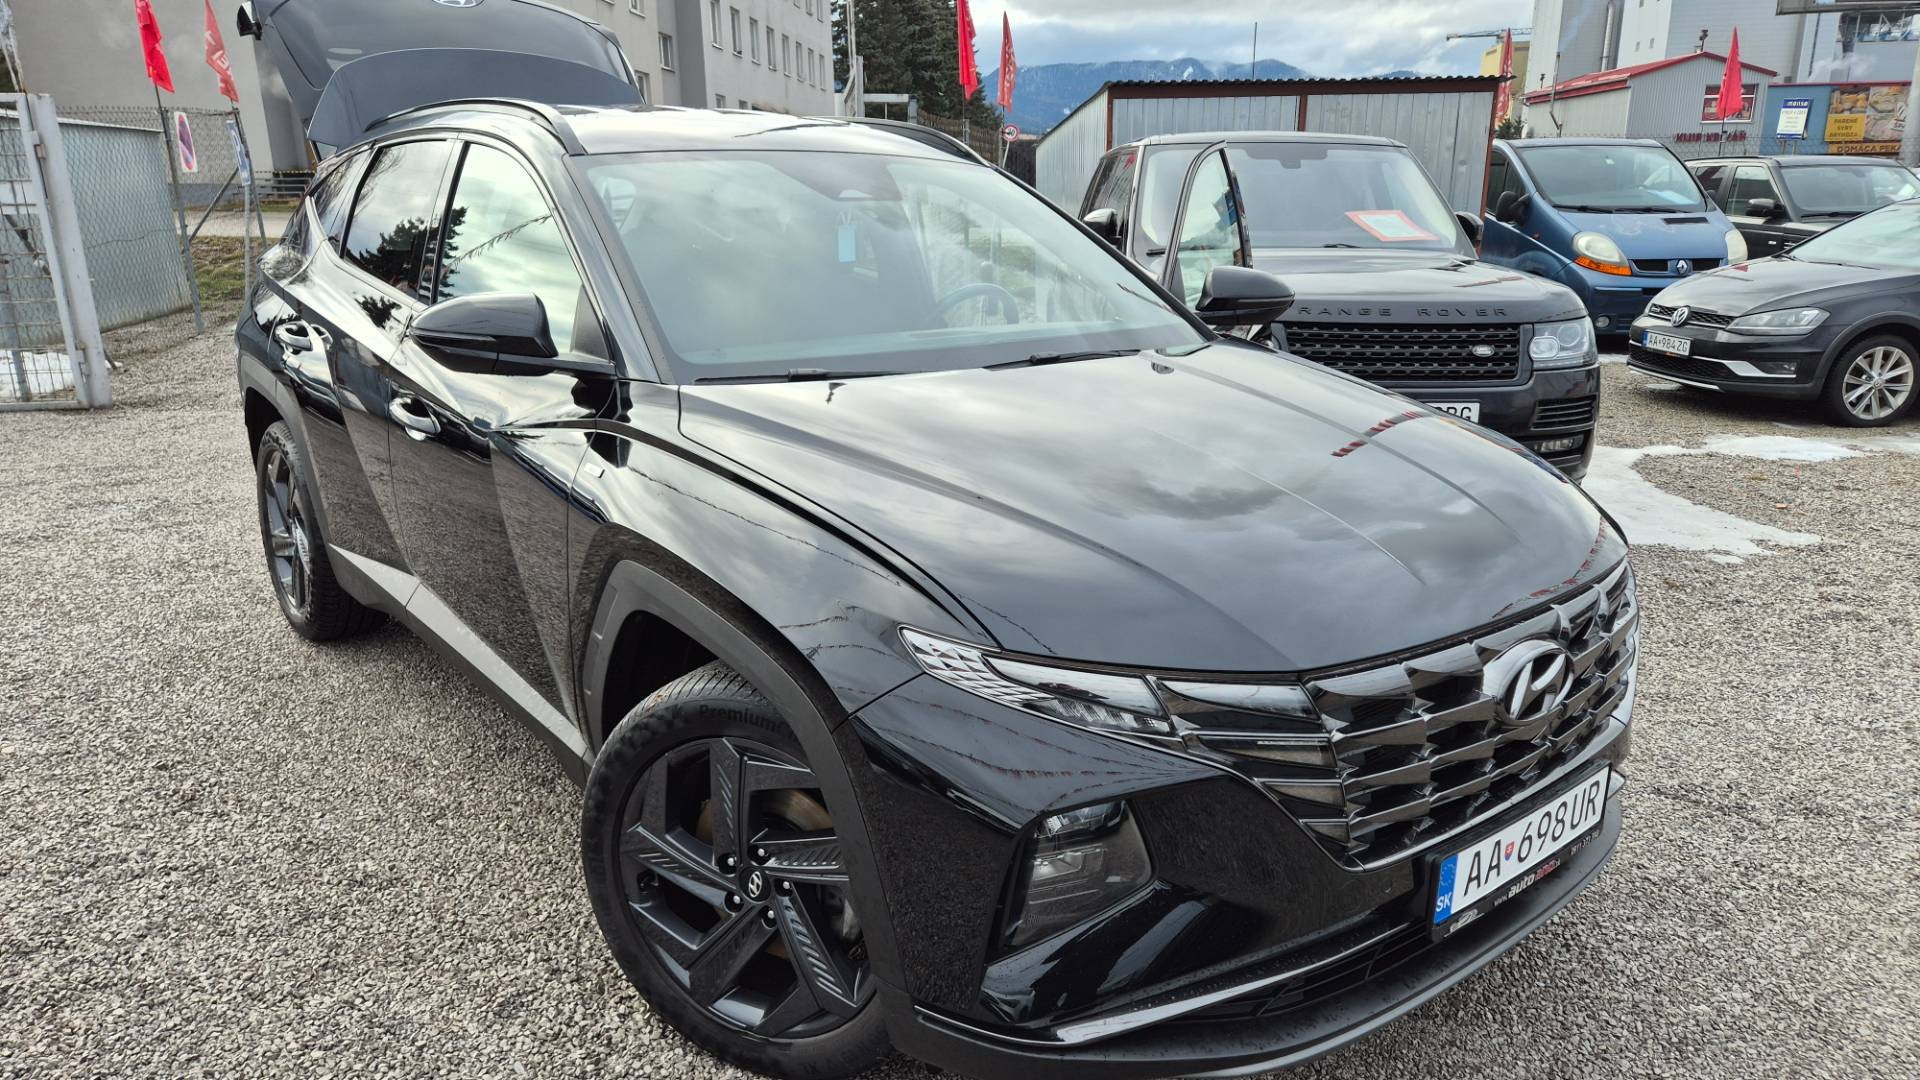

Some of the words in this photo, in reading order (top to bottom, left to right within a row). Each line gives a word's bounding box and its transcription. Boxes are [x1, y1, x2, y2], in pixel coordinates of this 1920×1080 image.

[1298, 306, 1393, 317] RANGE
[1416, 307, 1508, 317] ROVER
[1436, 892, 1452, 912] SK
